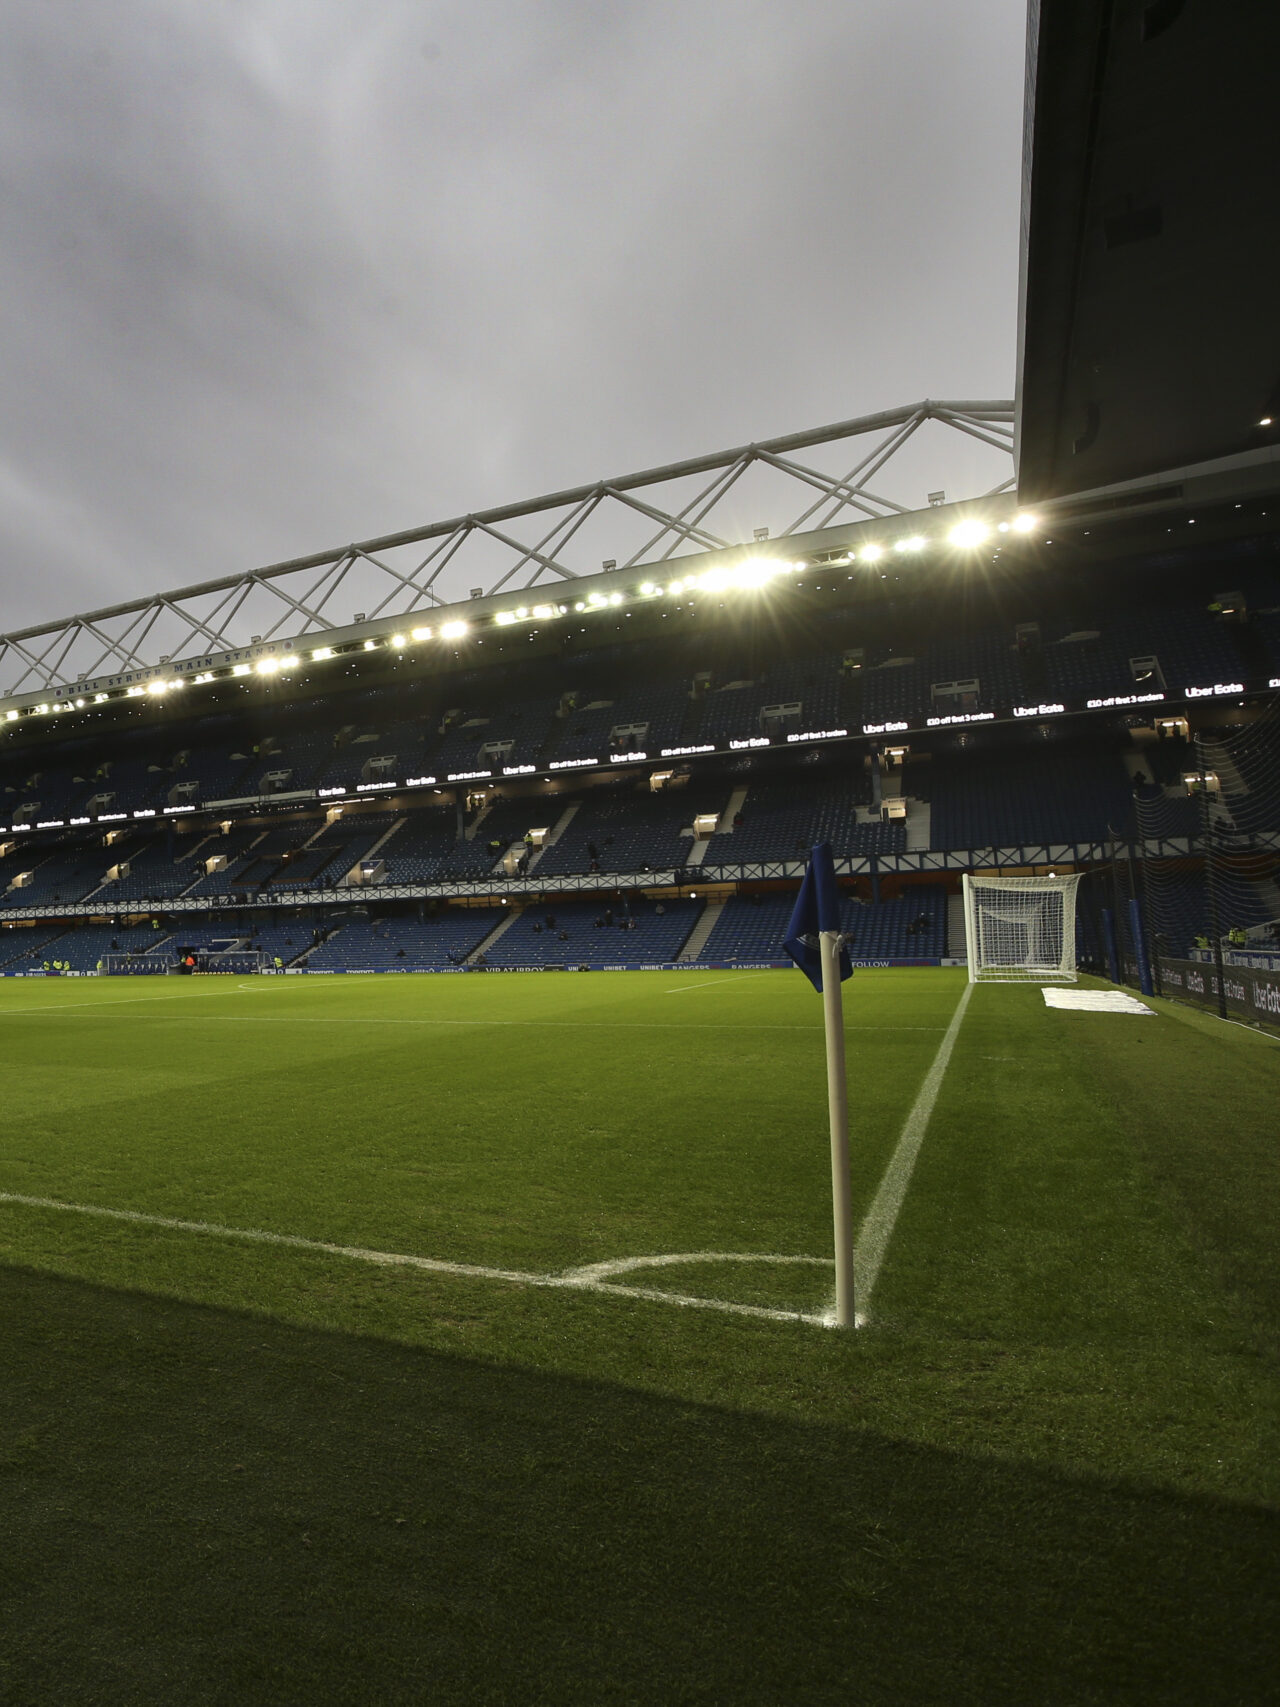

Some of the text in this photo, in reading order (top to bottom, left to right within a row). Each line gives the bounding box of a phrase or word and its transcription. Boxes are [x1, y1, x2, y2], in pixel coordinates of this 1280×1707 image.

[68, 646, 276, 695] BILL STRUTH MAIN STAND
[1185, 684, 1244, 697] Uber Eats
[1014, 704, 1064, 716] Uber Eats
[863, 722, 908, 733] Uber Eats
[730, 738, 770, 749] Uber Eats
[628, 752, 646, 760] Eats
